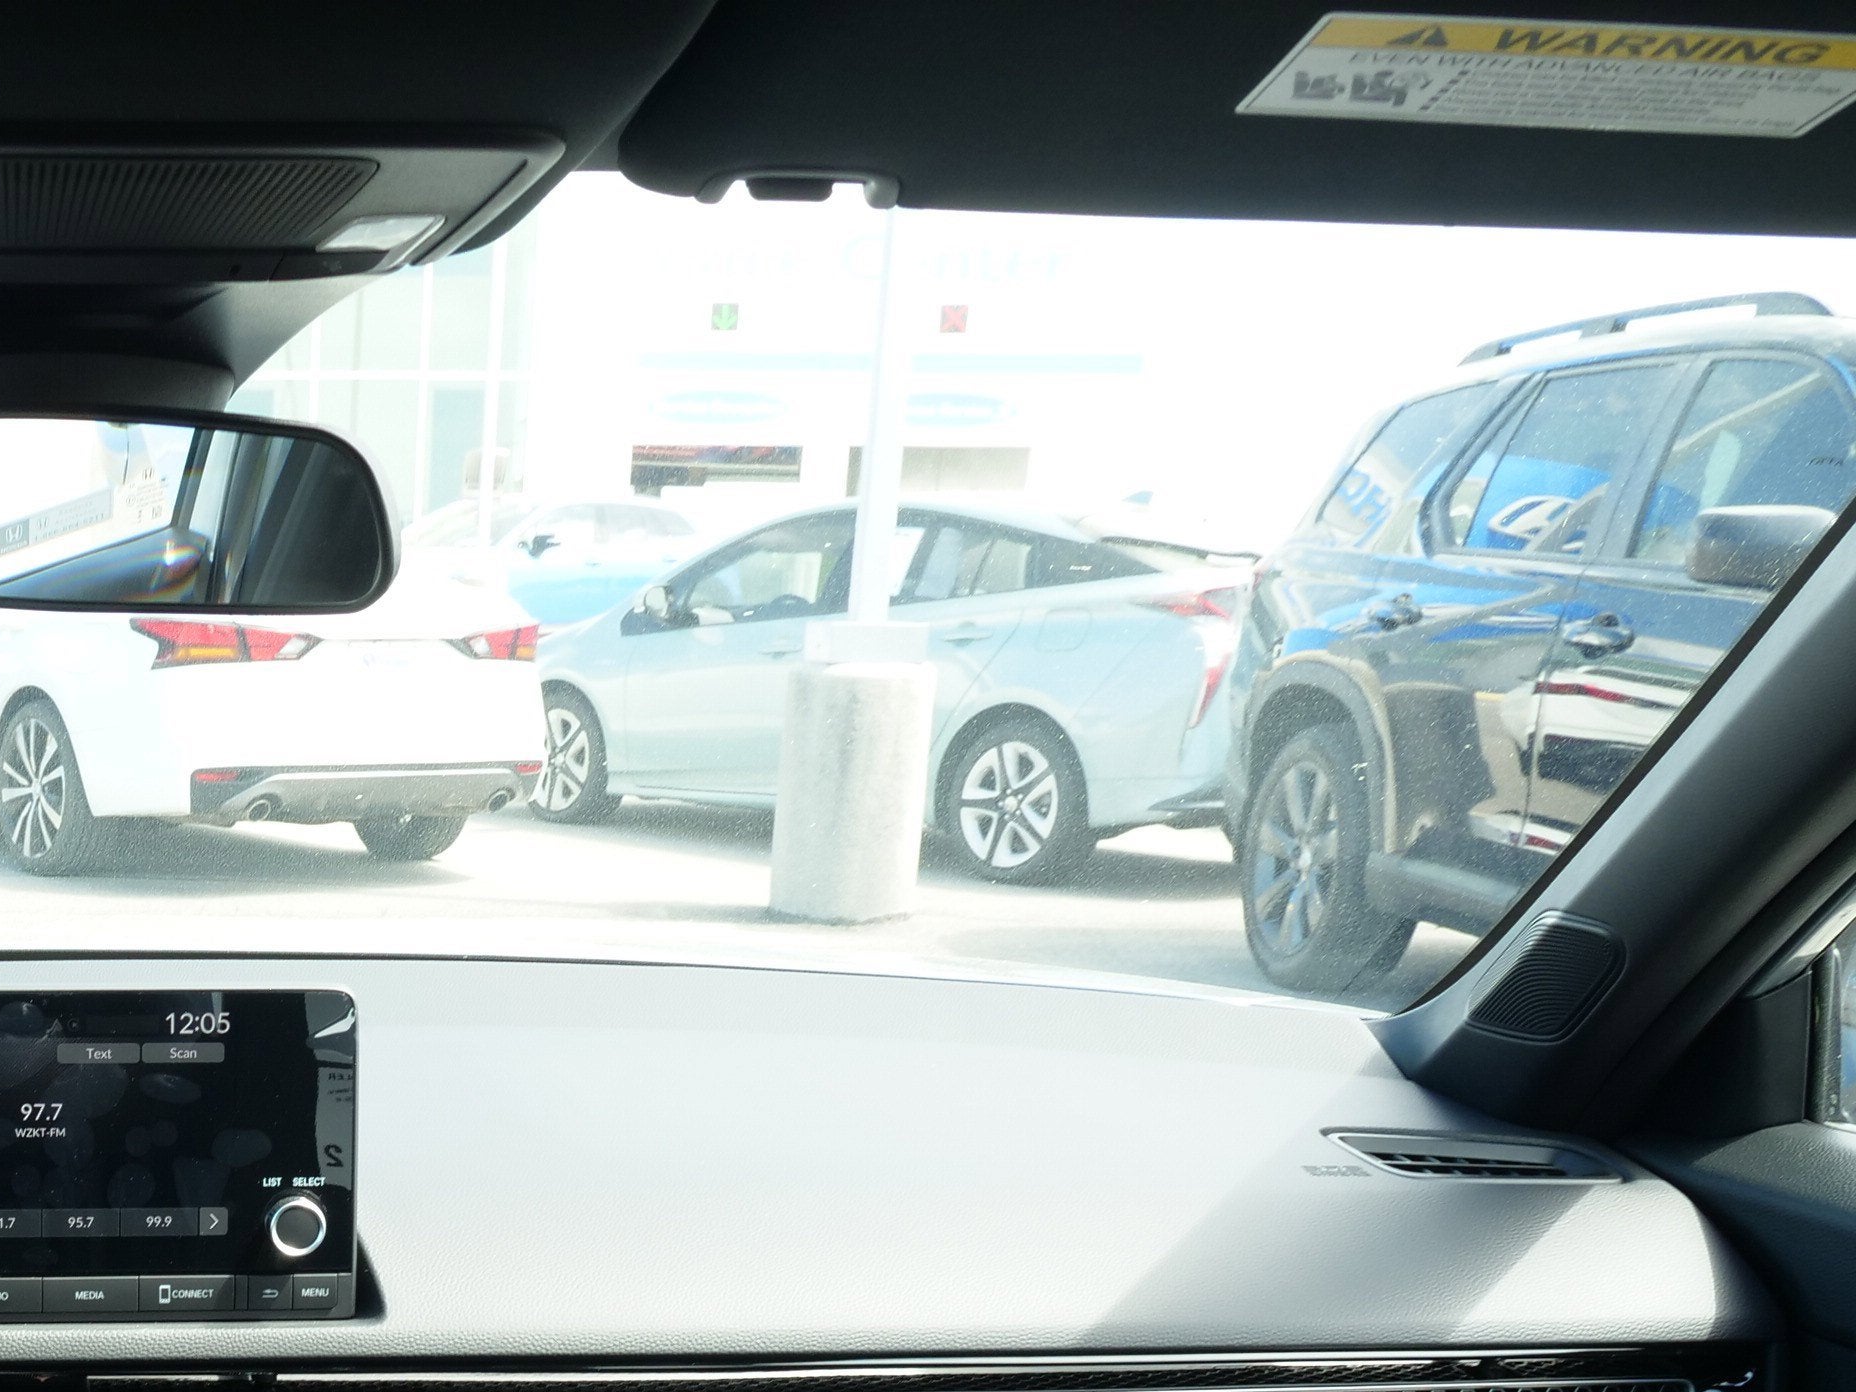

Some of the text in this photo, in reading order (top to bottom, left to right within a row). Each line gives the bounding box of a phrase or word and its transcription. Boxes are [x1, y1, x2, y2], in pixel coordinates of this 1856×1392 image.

[1494, 28, 1832, 65] WARNING
[165, 1012, 231, 1035] 12:05
[86, 1047, 197, 1060] Text Scan
[20, 1103, 63, 1121] 97.7
[14, 1127, 66, 1138] WZKT-FM
[262, 1176, 283, 1187] LIST
[292, 1176, 326, 1187] SELECT
[67, 1216, 95, 1229] 95.7
[145, 1215, 173, 1228] 99.9
[75, 1290, 105, 1300] MEDIA
[171, 1288, 214, 1299] CONNECT
[301, 1288, 330, 1298] MENU
